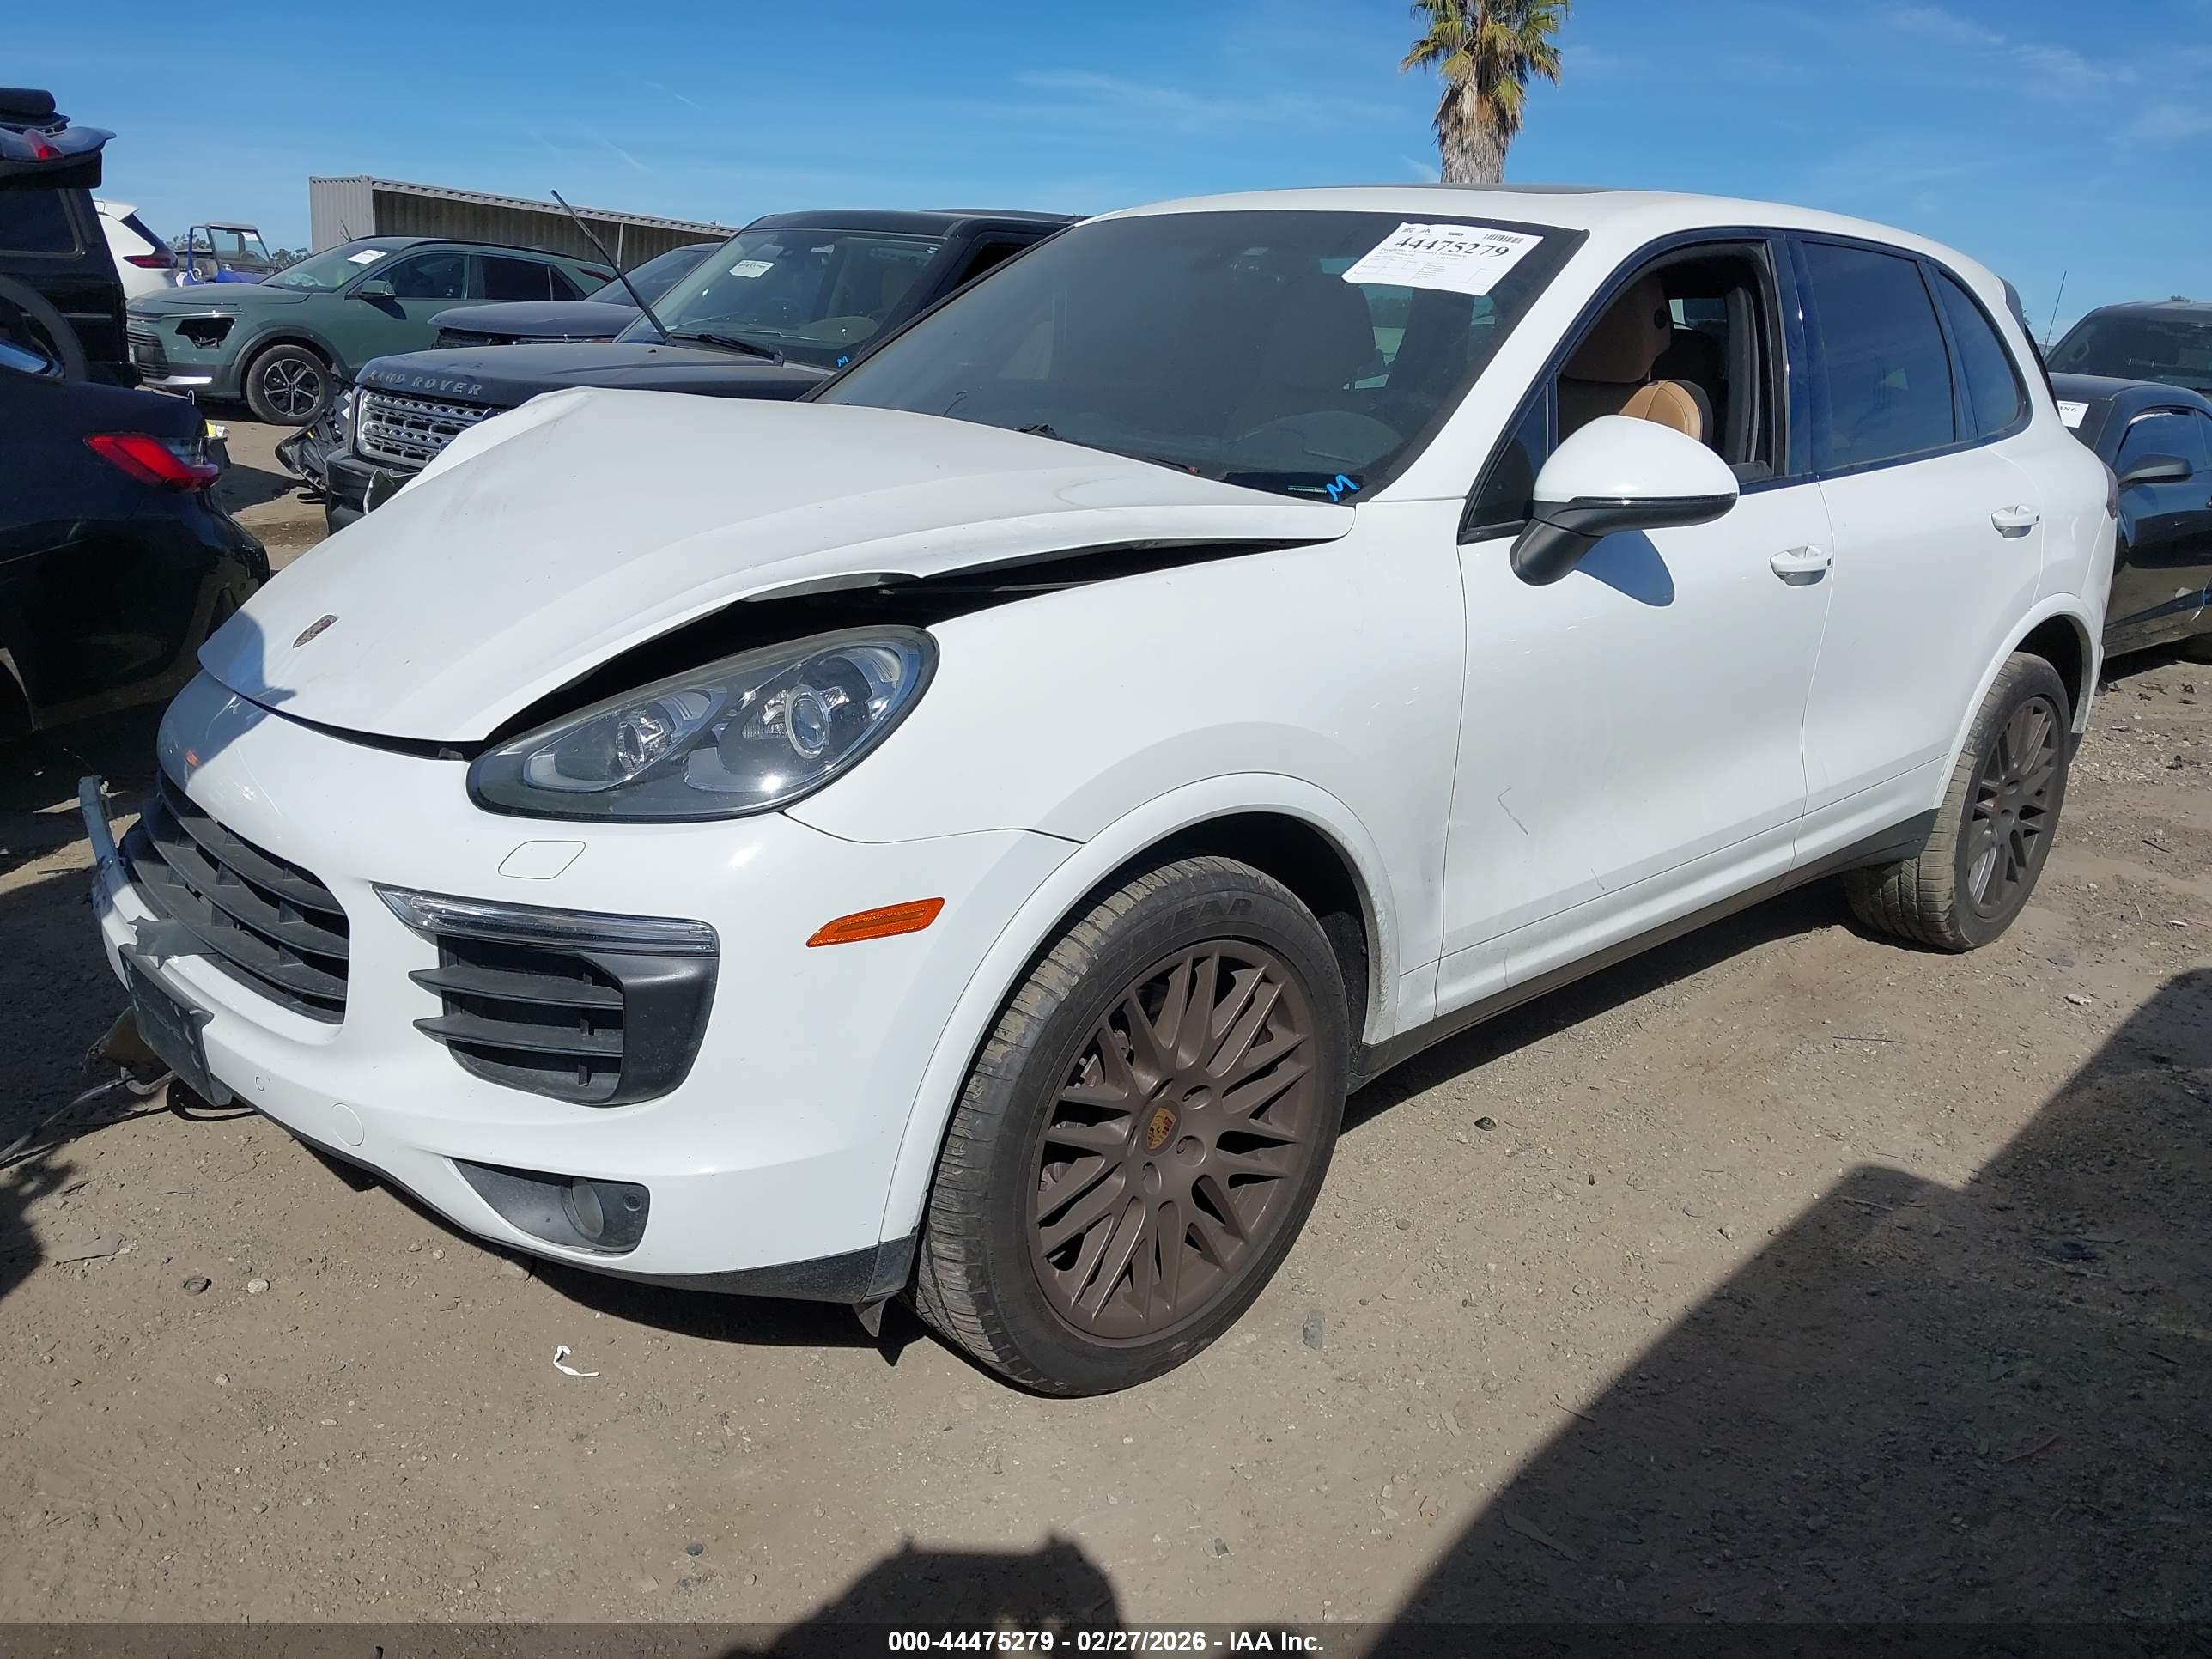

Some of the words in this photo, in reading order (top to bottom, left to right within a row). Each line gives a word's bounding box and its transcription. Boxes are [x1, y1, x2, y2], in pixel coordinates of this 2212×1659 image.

[1395, 236, 1510, 258] 44475279
[412, 376, 483, 396] ROVER
[1326, 474, 1361, 502] M
